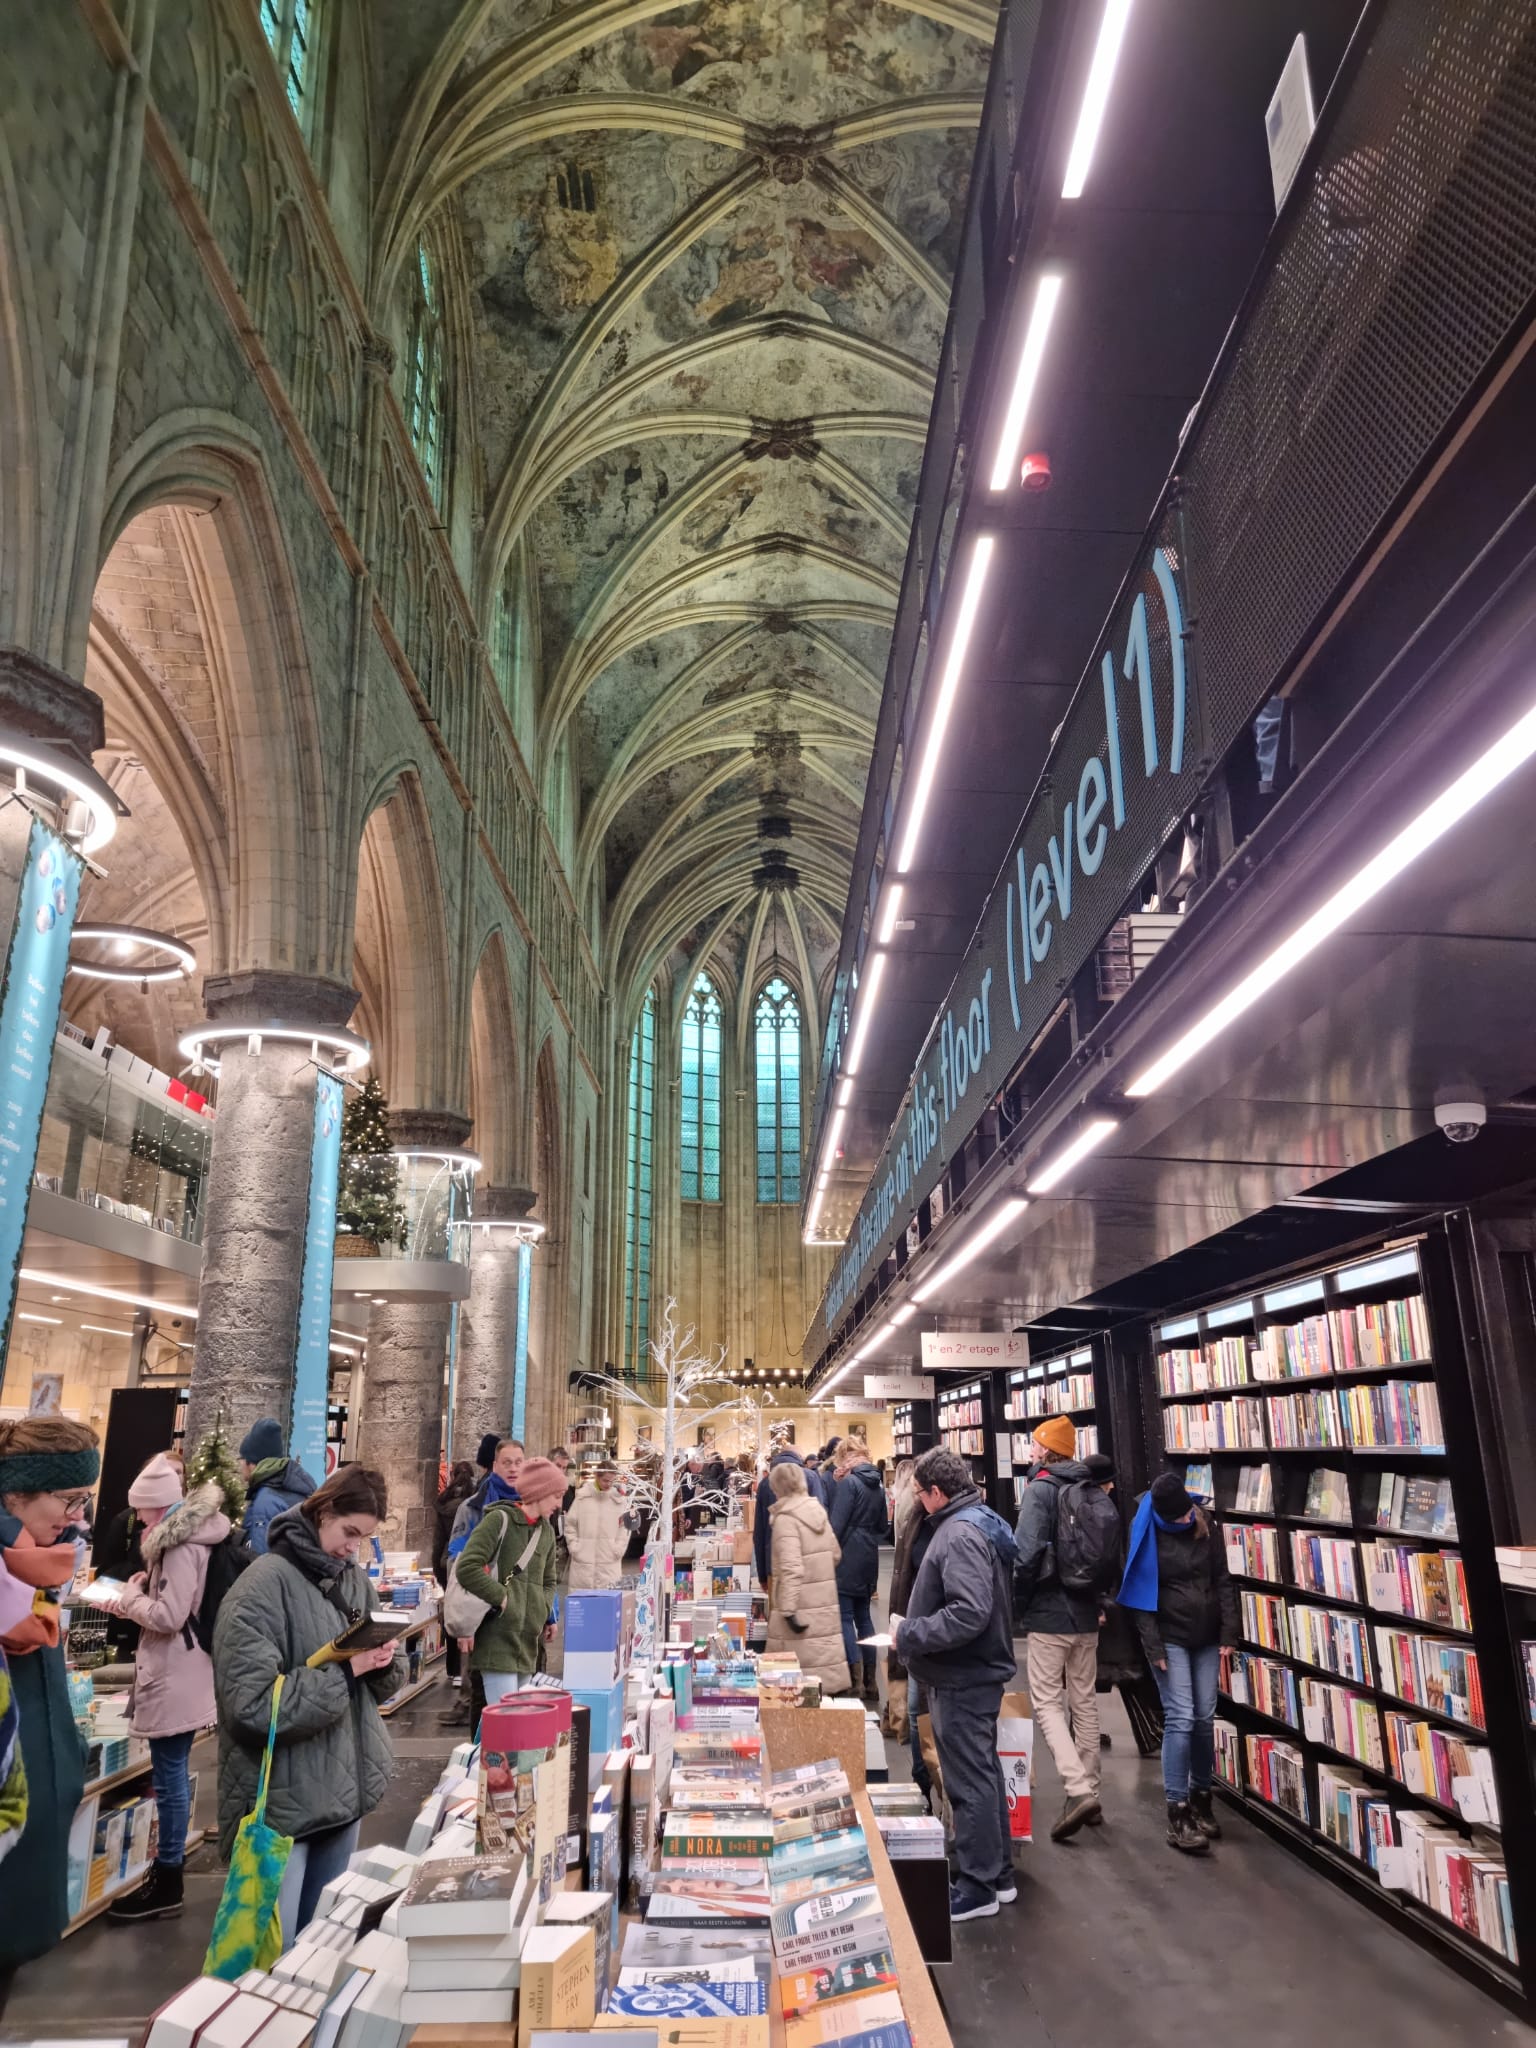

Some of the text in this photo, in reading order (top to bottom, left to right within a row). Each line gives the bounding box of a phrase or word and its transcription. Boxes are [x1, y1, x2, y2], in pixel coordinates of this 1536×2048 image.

[859, 1170, 895, 1268] literature
[896, 1140, 911, 1204] on
[910, 1071, 938, 1176] this
[940, 967, 992, 1124] floor
[1006, 650, 1125, 1031] (level
[1123, 547, 1186, 778] 1)
[969, 1345, 1000, 1356] etage
[686, 1837, 723, 1855] NORA
[782, 1940, 795, 1951] CARL
[830, 1927, 840, 1937] HET
[784, 1958, 797, 1969] CARL
[832, 1945, 842, 1956] HET
[556, 1964, 590, 2004] STEPHEN
